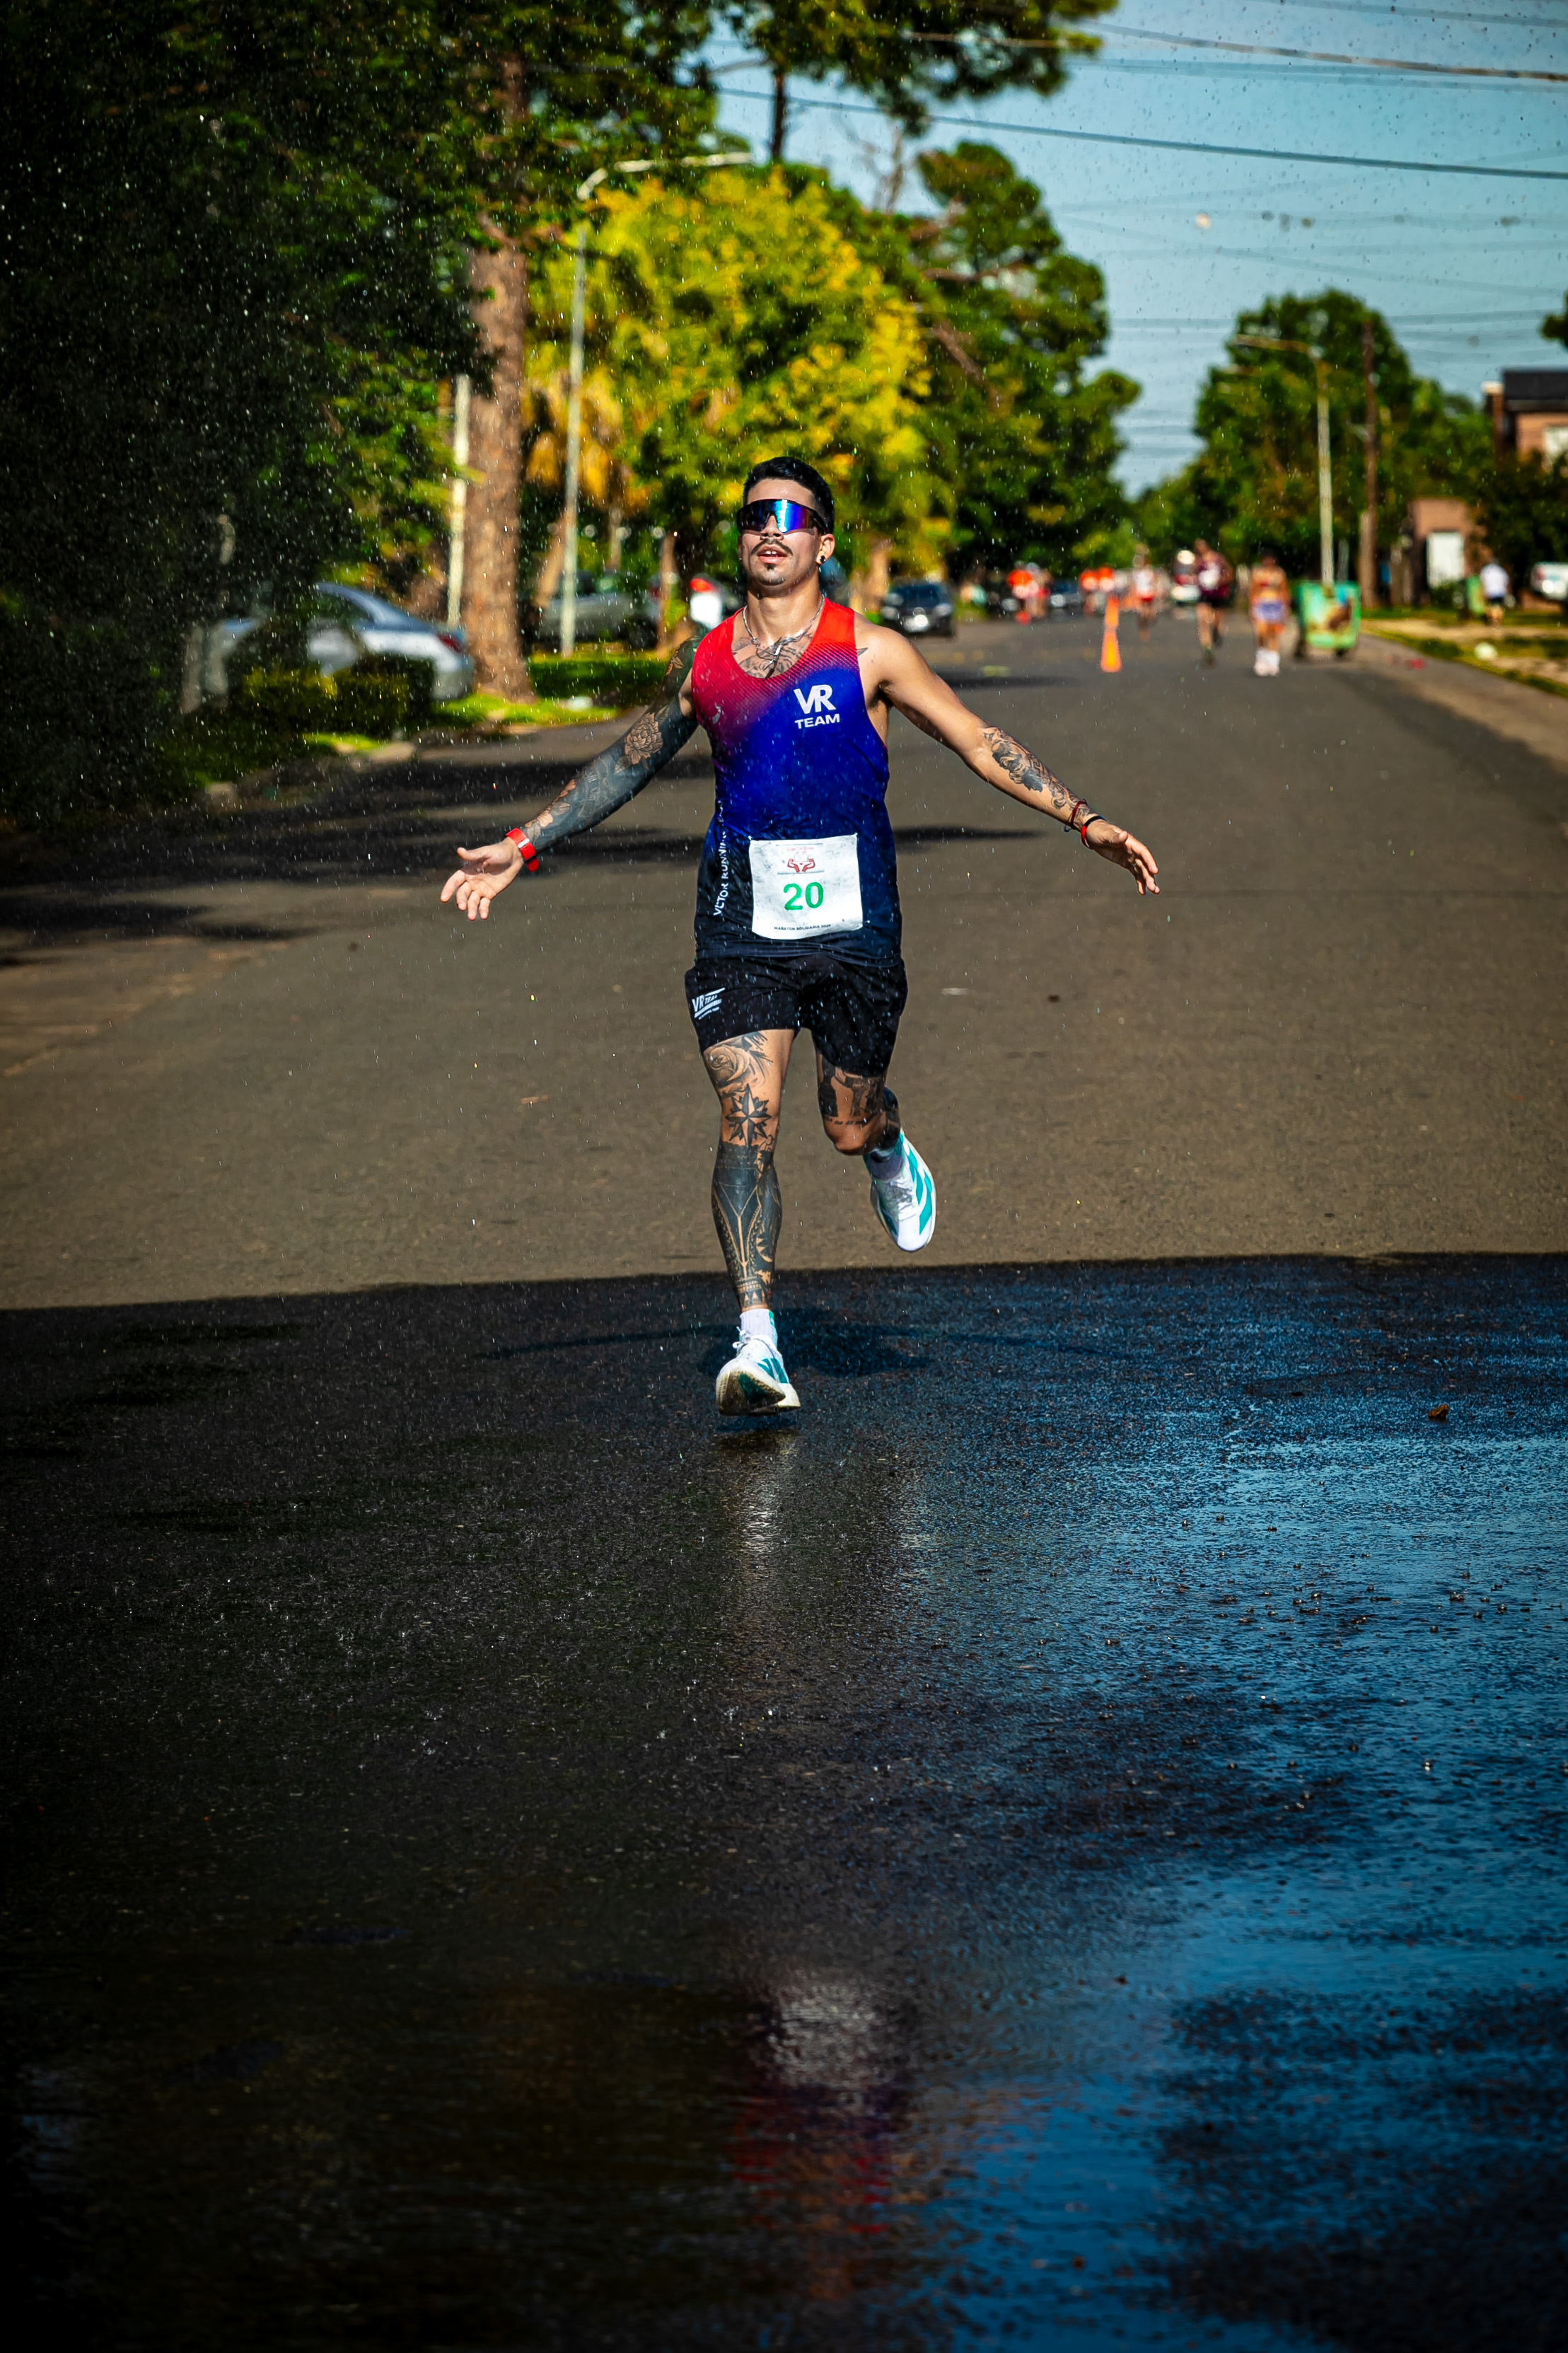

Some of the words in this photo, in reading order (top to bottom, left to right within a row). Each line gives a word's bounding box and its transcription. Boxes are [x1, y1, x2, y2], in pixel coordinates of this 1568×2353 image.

[794, 684, 836, 714] VR
[794, 713, 840, 729] TEAM
[783, 881, 824, 910] 20
[692, 995, 704, 1012] VR
